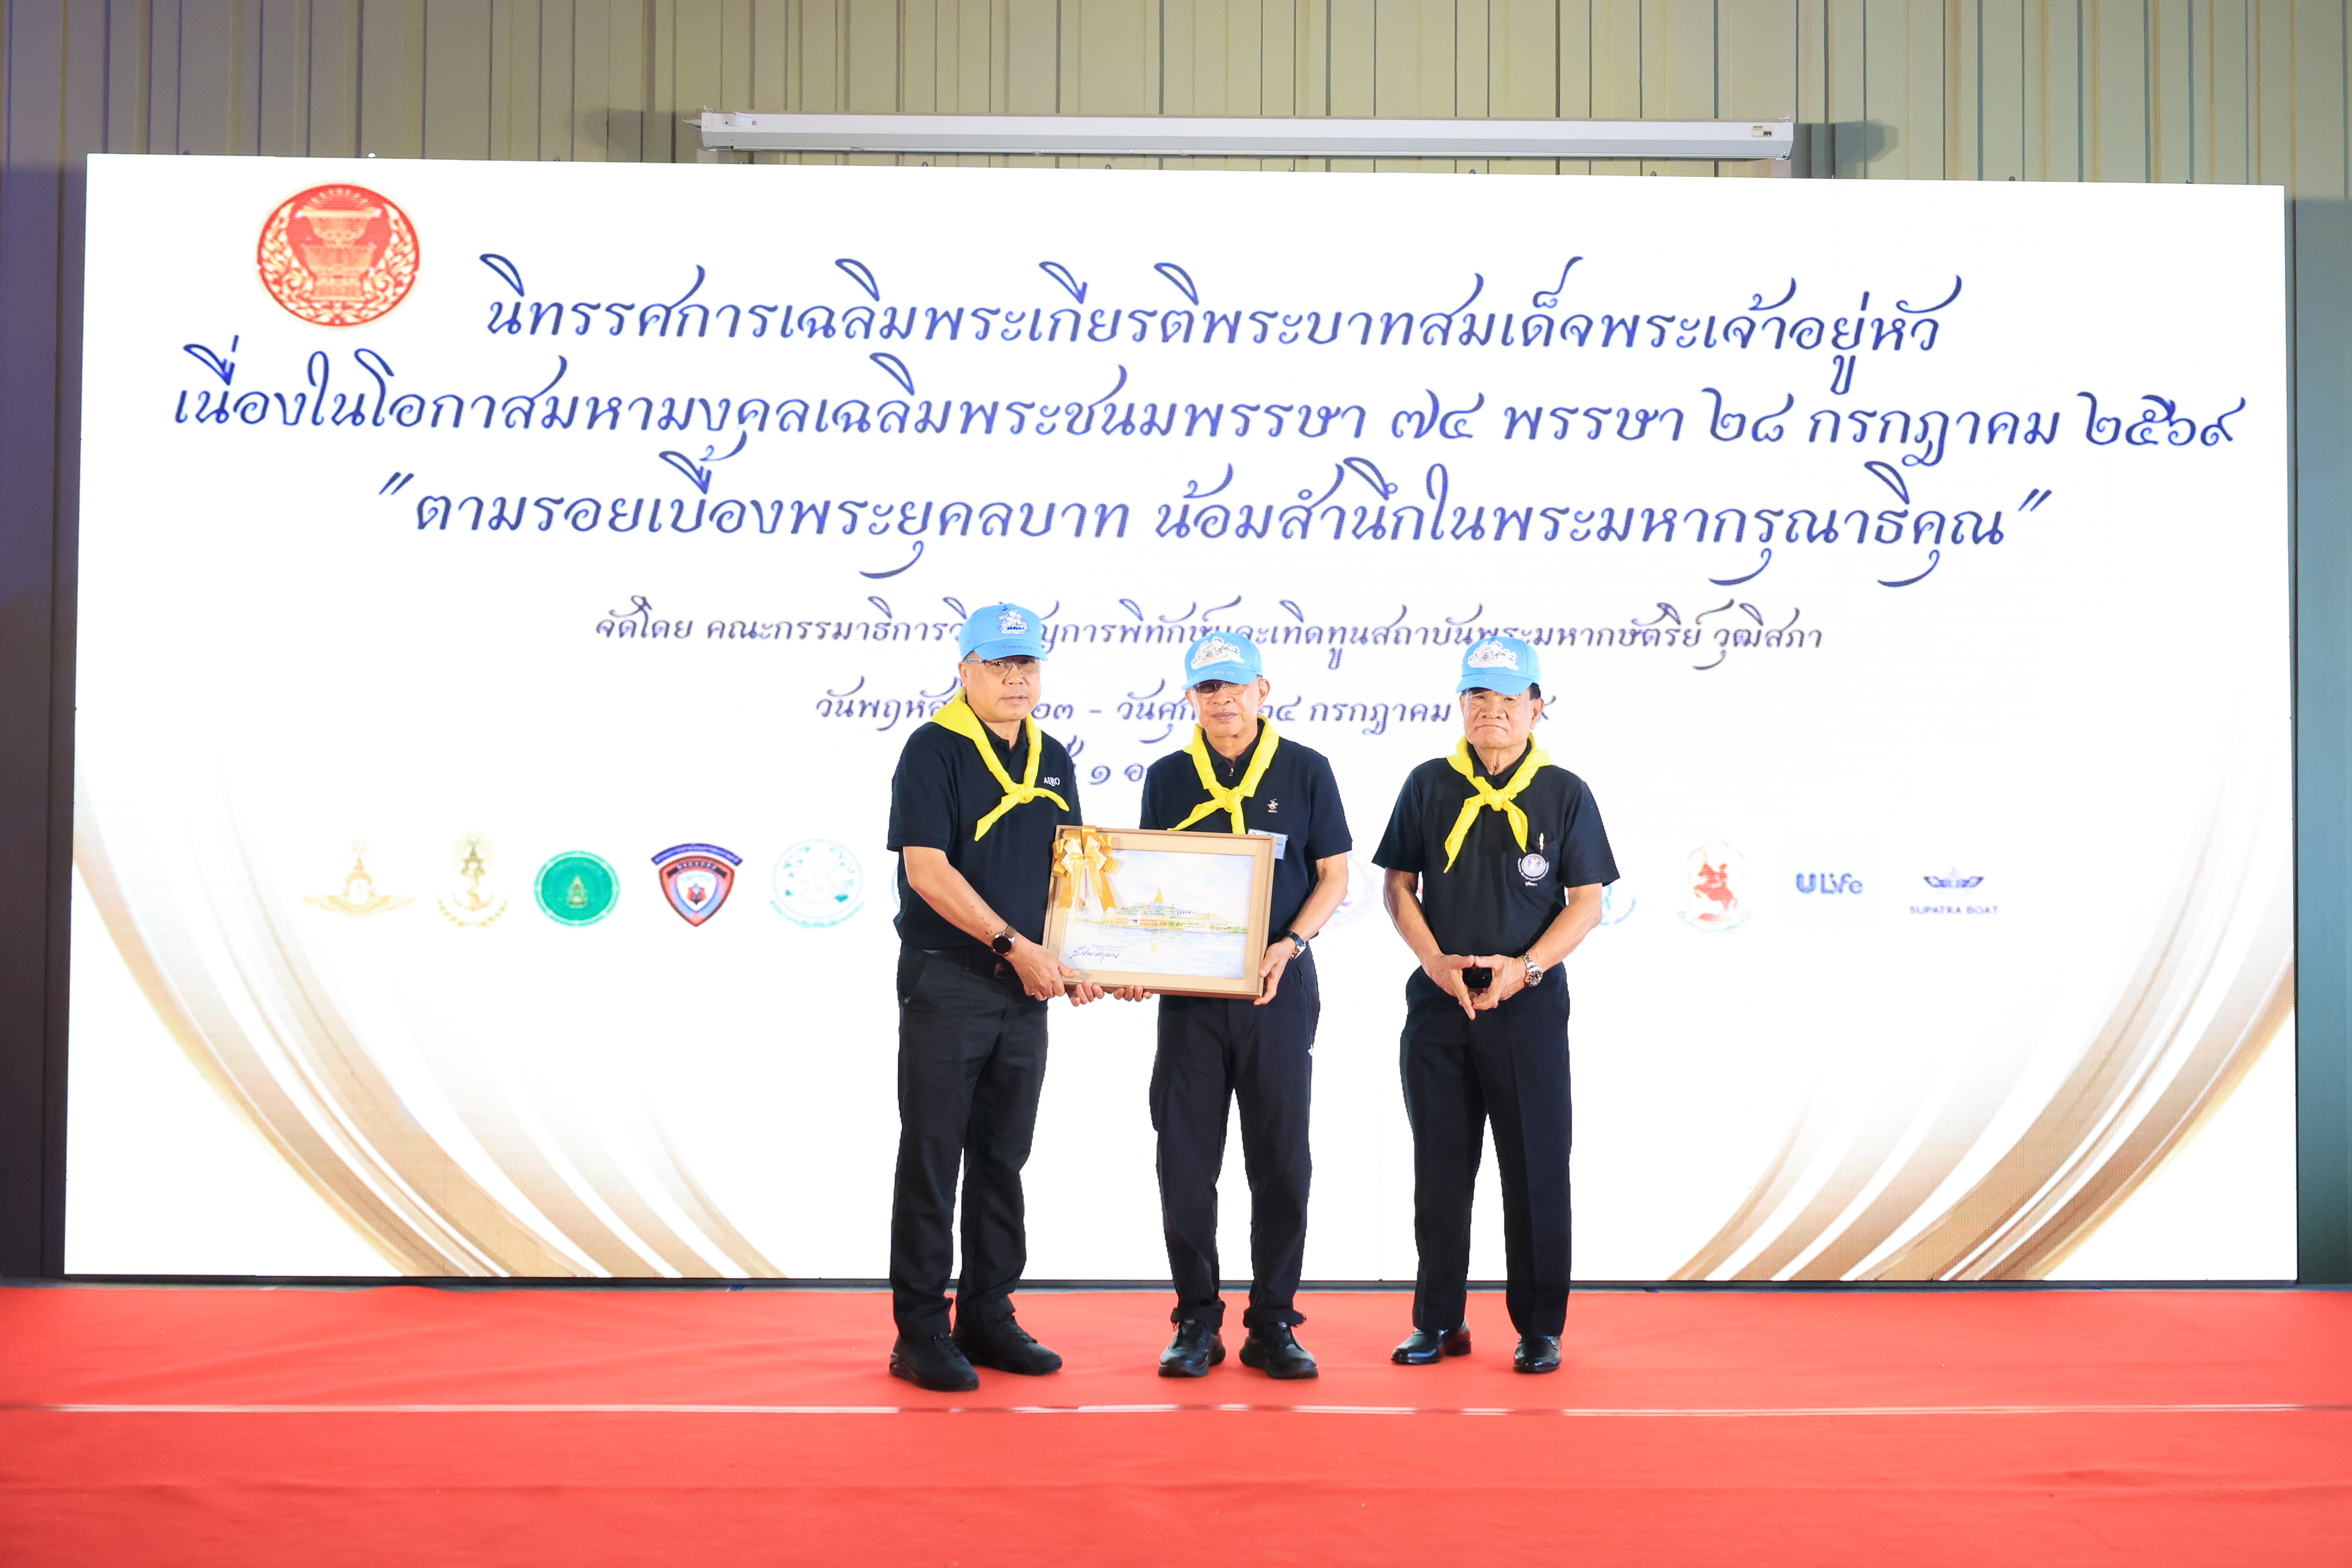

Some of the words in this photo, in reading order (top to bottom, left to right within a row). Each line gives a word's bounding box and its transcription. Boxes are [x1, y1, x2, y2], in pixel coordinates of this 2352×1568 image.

[479, 253, 1962, 396] นิทรรศการเฉลิมพระเกียรติพระบาทสมเด็จพระเจ้าอยู่หัว
[174, 334, 1366, 439] เนื่องในโอกาสมหามงคลเฉลิมพระชนมพรรษา
[1391, 388, 1485, 440] ๗๔
[1504, 406, 1684, 442] พรรษา
[1701, 387, 1795, 443] ๒๘
[1808, 409, 2060, 467] กรกฎาคม
[2076, 391, 2246, 447] ๒๕๖๙
[595, 594, 694, 639] จัดโดย
[1692, 602, 1823, 671] วุฒิสภา
[1309, 702, 1452, 736] กรกฎาคม
[1909, 906, 1962, 914] SUPATRA
[1966, 906, 1998, 914] BOAT
